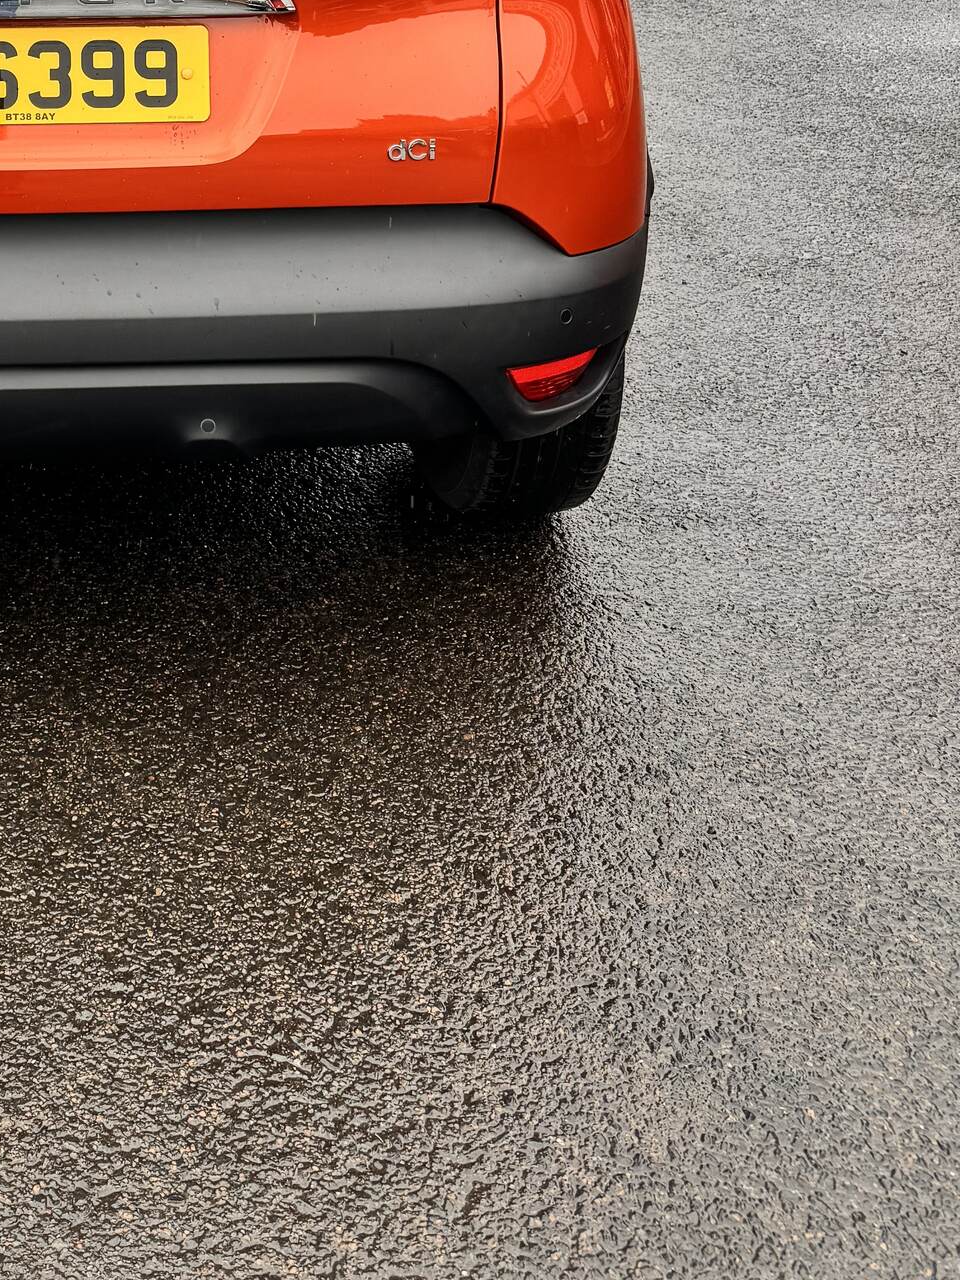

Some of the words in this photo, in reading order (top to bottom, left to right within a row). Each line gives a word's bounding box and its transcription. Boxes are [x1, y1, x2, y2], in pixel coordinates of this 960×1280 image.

[6, 112, 32, 121] BT38
[35, 112, 56, 120] 8AY
[388, 138, 436, 161] dCi
